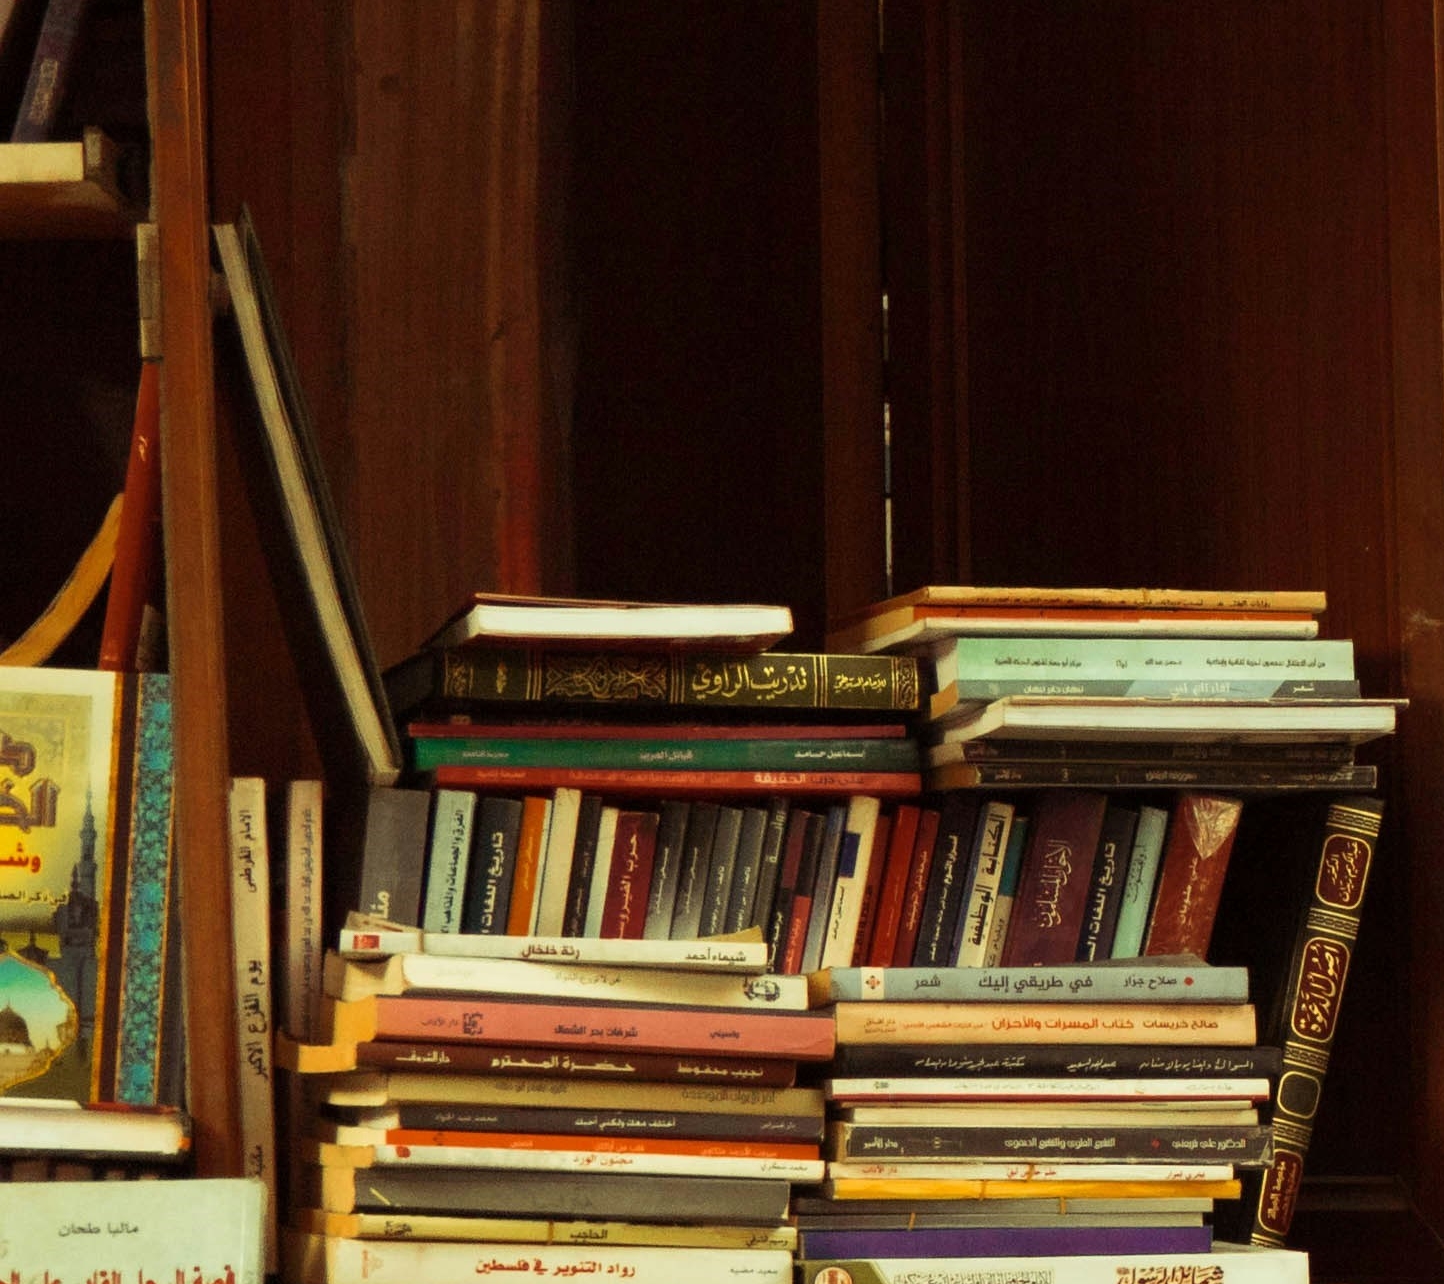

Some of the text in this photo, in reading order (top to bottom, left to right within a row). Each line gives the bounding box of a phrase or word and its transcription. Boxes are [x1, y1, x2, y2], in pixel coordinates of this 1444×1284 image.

[965, 814, 1005, 946] الكتابة الوظيفية
[521, 943, 555, 959] خلخال
[913, 974, 942, 990] شعر
[1012, 973, 1065, 992] طريقي
[1068, 975, 1094, 991] في
[1149, 974, 1178, 990] صلاح
[1044, 1016, 1100, 1031] المسرات
[1102, 1017, 1135, 1031] كتاب
[490, 1052, 765, 1079] نجيب محفوظ حضرة المحترم
[599, 1153, 634, 1167] مجنون
[474, 1258, 637, 1278] رواد التنوير في فلسطين
